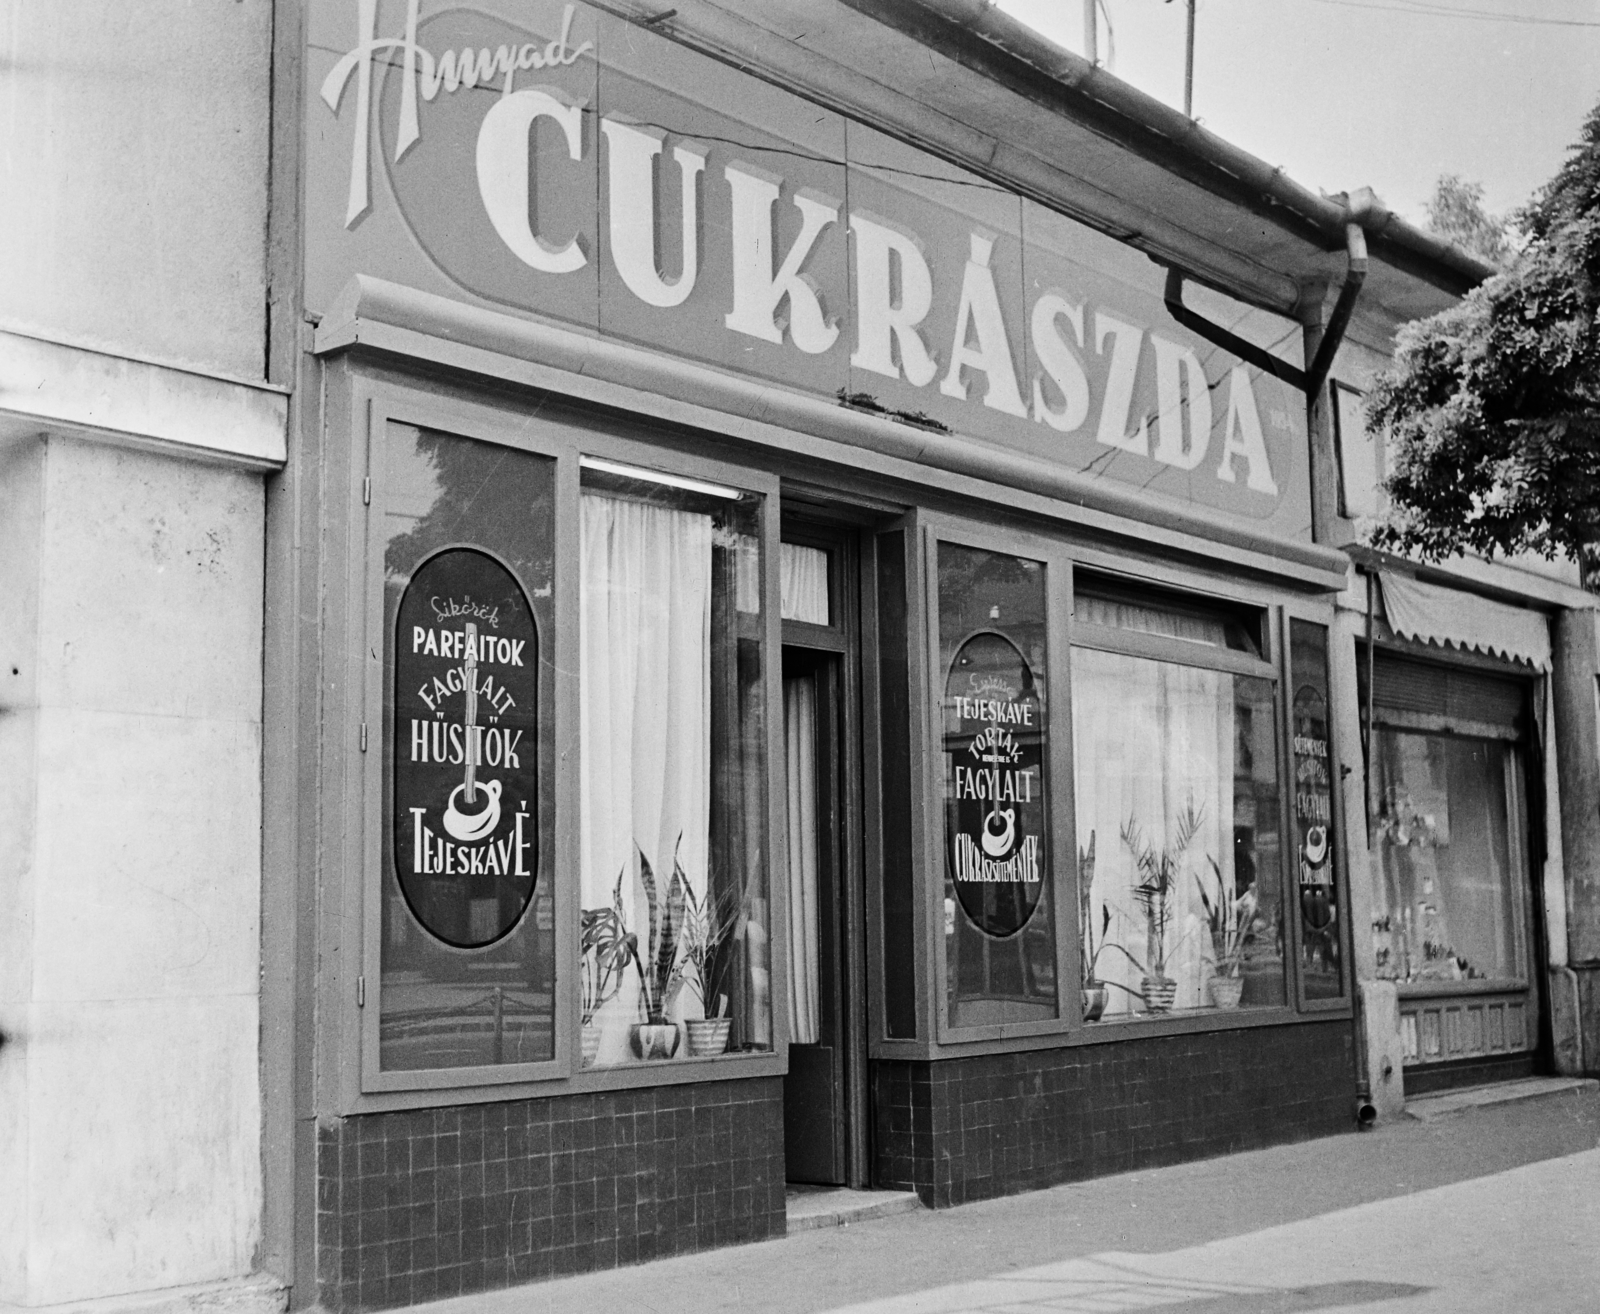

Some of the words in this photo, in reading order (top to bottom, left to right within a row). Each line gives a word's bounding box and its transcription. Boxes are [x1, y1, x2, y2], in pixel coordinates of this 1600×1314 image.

[476, 88, 1279, 497] CUKRÁSZDA
[413, 626, 526, 667] PARFAITOK
[417, 666, 516, 715] FAGYLALT
[954, 696, 1033, 726] TEJESKÁVÉ
[968, 727, 1024, 764] TORTÁK
[955, 766, 1034, 803] FAGYLALT
[409, 800, 531, 876] TEJESKÁVÉ
